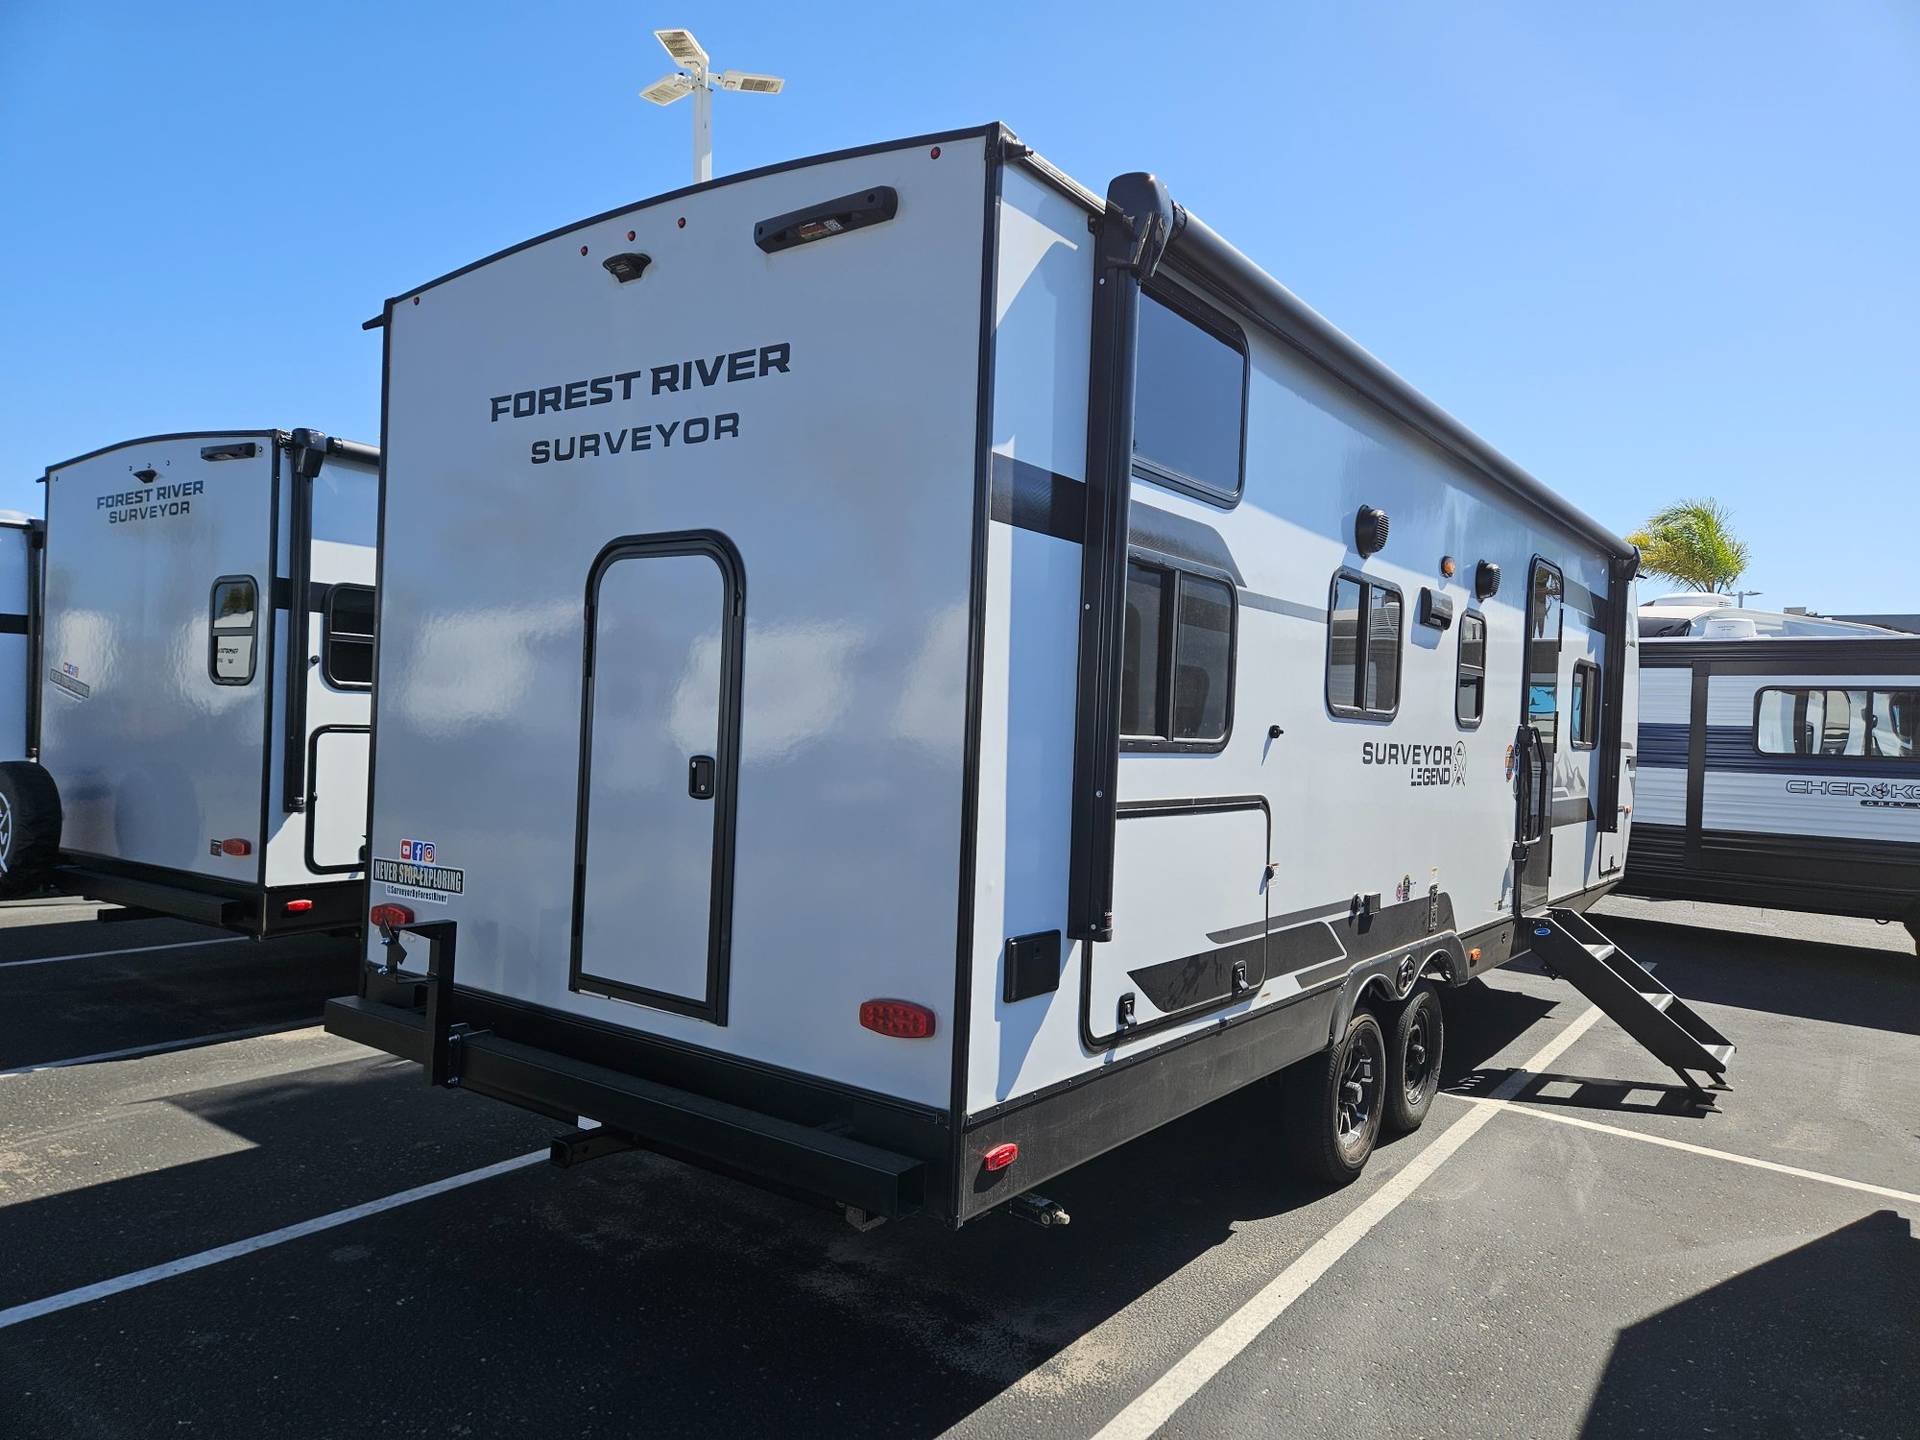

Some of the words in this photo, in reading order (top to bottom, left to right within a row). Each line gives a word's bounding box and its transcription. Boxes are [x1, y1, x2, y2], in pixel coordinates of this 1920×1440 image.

[490, 371, 641, 422] FOREST
[650, 342, 791, 395] RIVER
[531, 412, 740, 464] SURVEYOR
[96, 488, 153, 510] FOREST
[156, 480, 204, 500] RIVER
[108, 501, 190, 524] SURVEYOR
[1362, 741, 1453, 765] SURVEYOR
[1410, 767, 1451, 787] LEGEND
[374, 860, 398, 882] NEVER
[399, 863, 420, 885] STOP
[419, 867, 462, 892] EXPLORING
